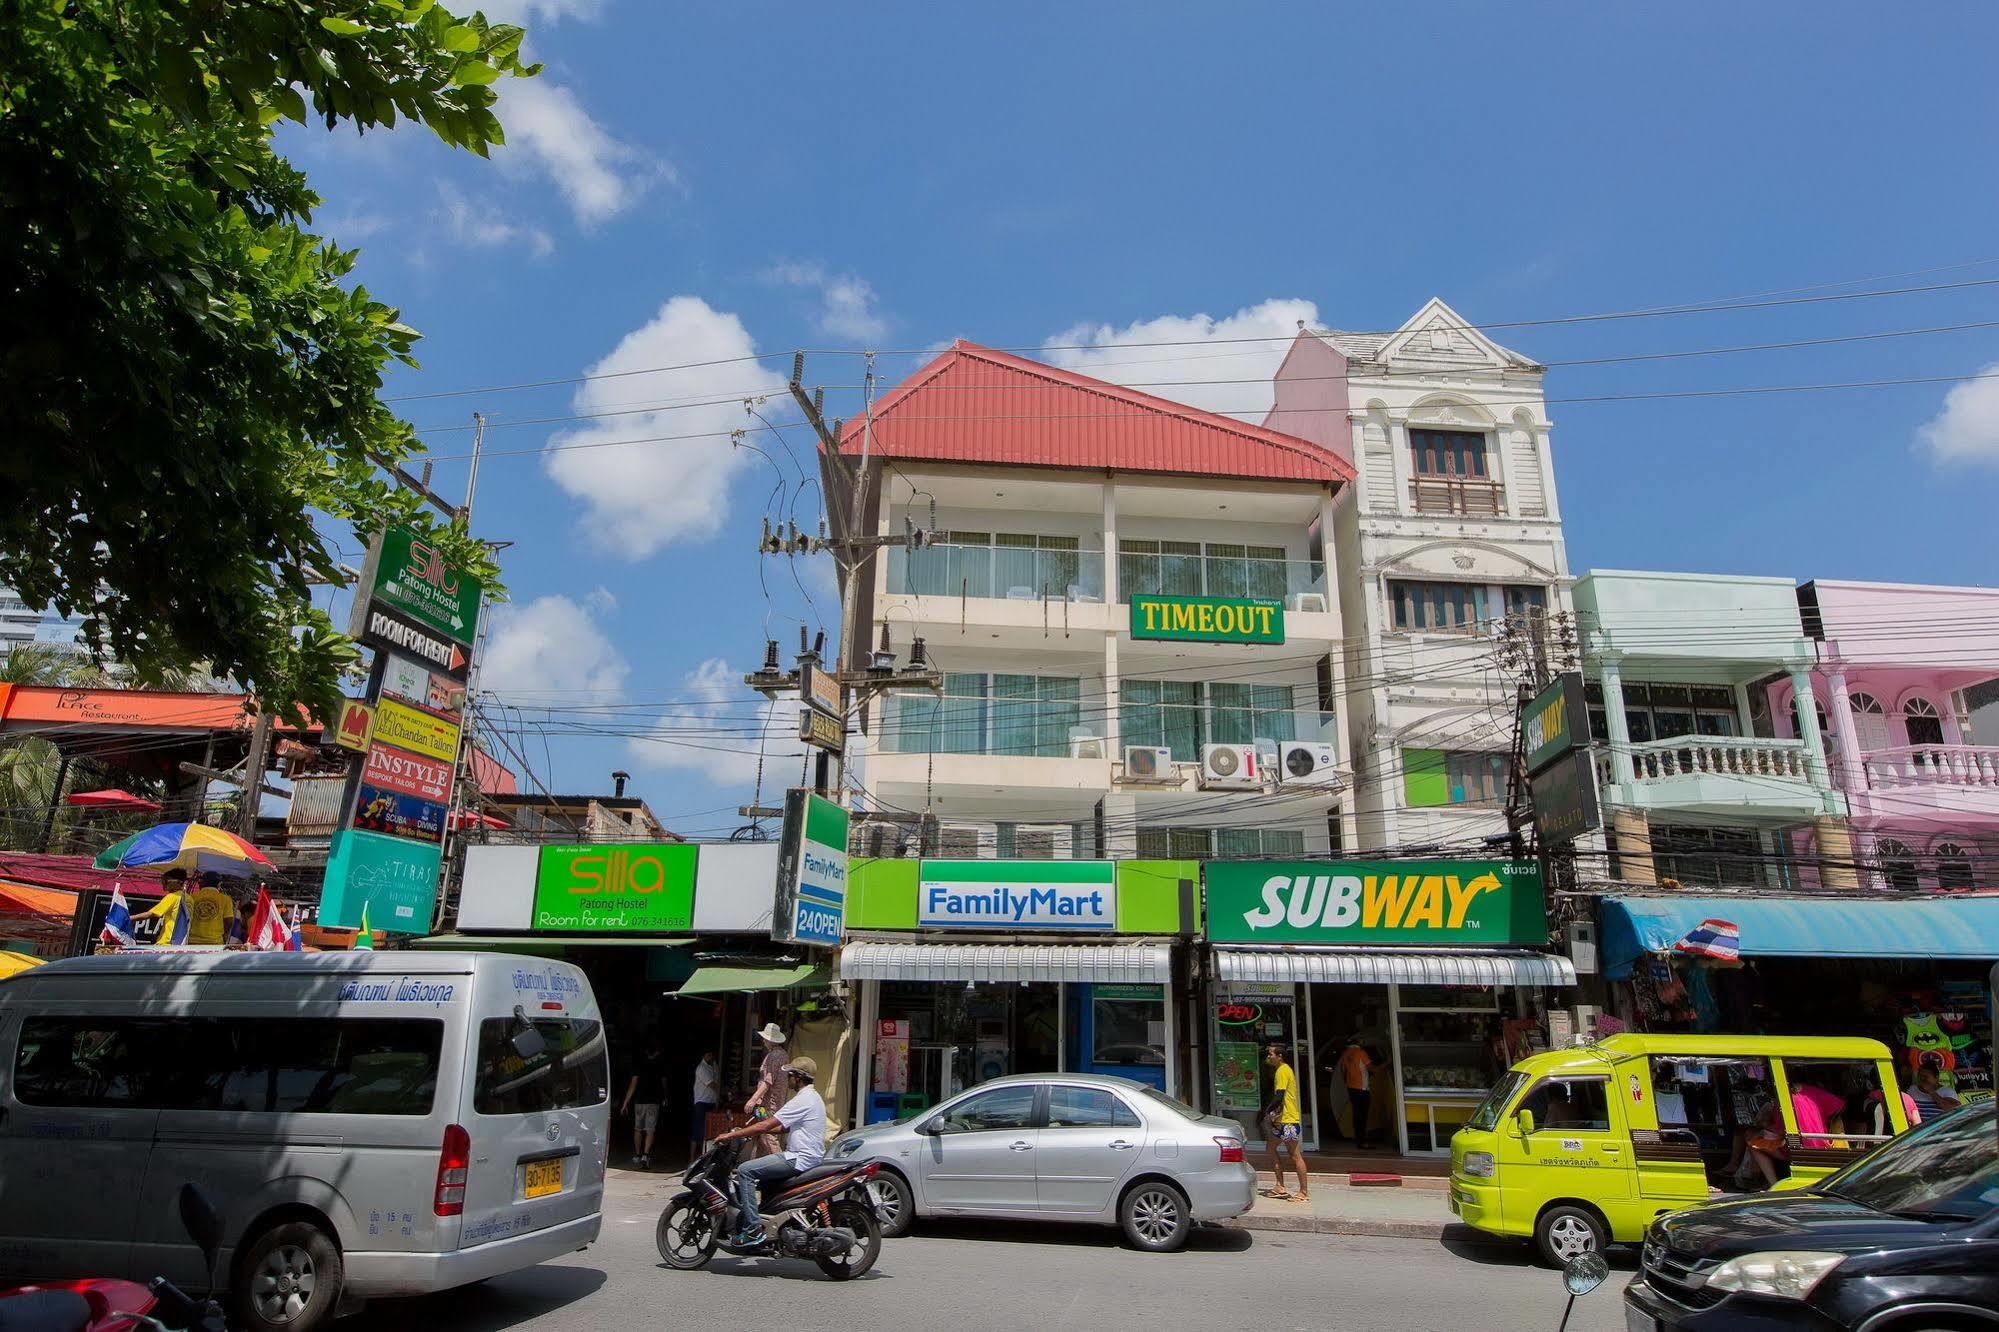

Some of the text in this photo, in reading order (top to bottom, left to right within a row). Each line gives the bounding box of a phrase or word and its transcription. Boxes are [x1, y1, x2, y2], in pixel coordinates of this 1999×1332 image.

[398, 568, 460, 612] Patong Hostel
[1140, 602, 1275, 635] TIMEOUT
[370, 612, 451, 666] ROOM FOR RENT
[394, 723, 428, 746] Chandan
[430, 734, 454, 754] Tailors
[1527, 692, 1566, 756] SUBWAY
[367, 769, 393, 784] BESPOKE
[368, 750, 448, 787] INSTYLE
[385, 813, 407, 825] SCUBA
[417, 820, 438, 831] DIVING
[804, 852, 844, 881] FamilyMart
[1501, 862, 1537, 876] ซับเวย์
[580, 897, 648, 911] Patong Hostel
[928, 887, 1103, 921] FamilyMart
[1242, 870, 1504, 932] SUBWAY
[538, 911, 579, 926] Room
[581, 909, 599, 926] for
[602, 912, 629, 927] rent
[1217, 1004, 1255, 1020] OPEN
[527, 1166, 561, 1189] 30-7135
[387, 1212, 396, 1222] 15
